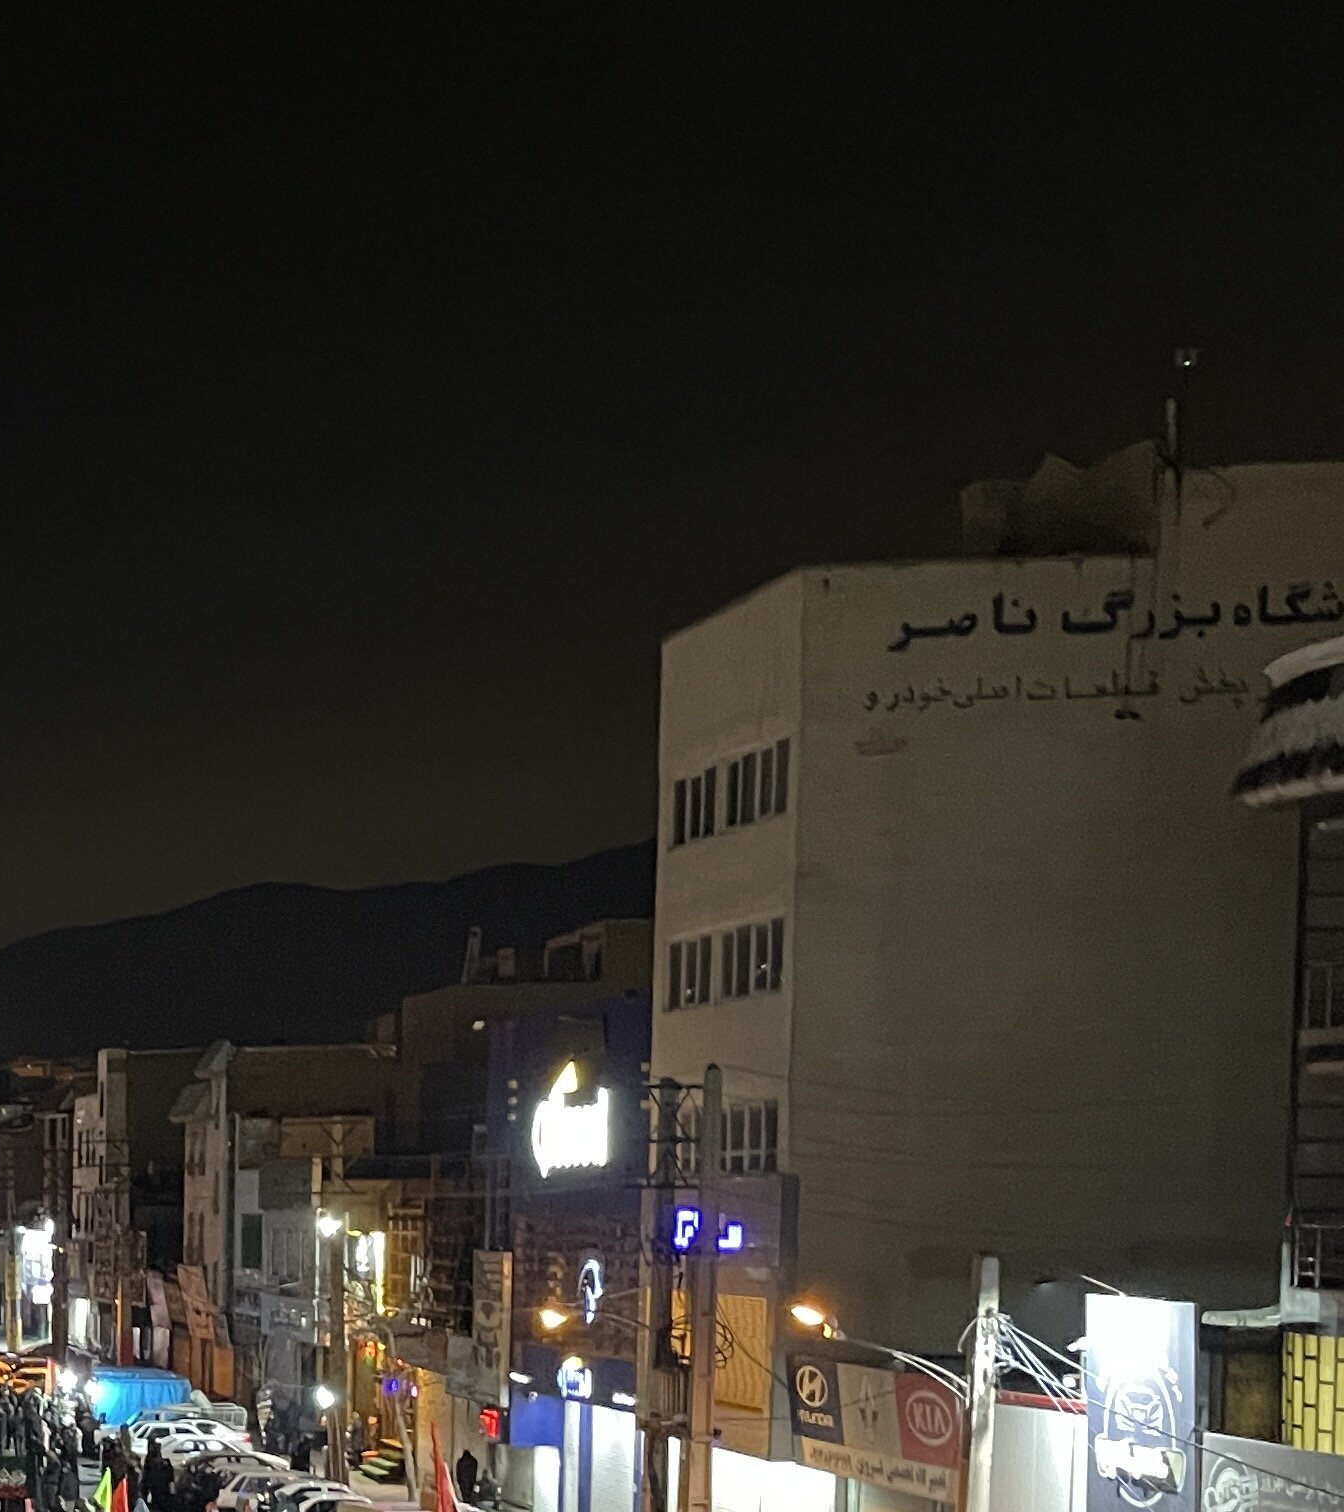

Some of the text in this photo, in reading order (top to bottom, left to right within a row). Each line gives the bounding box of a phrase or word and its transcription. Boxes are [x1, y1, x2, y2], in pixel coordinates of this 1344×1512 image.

[886, 591, 1038, 652] ناصر
[1060, 588, 1221, 641] بزرگ
[912, 1402, 947, 1435] KIA
